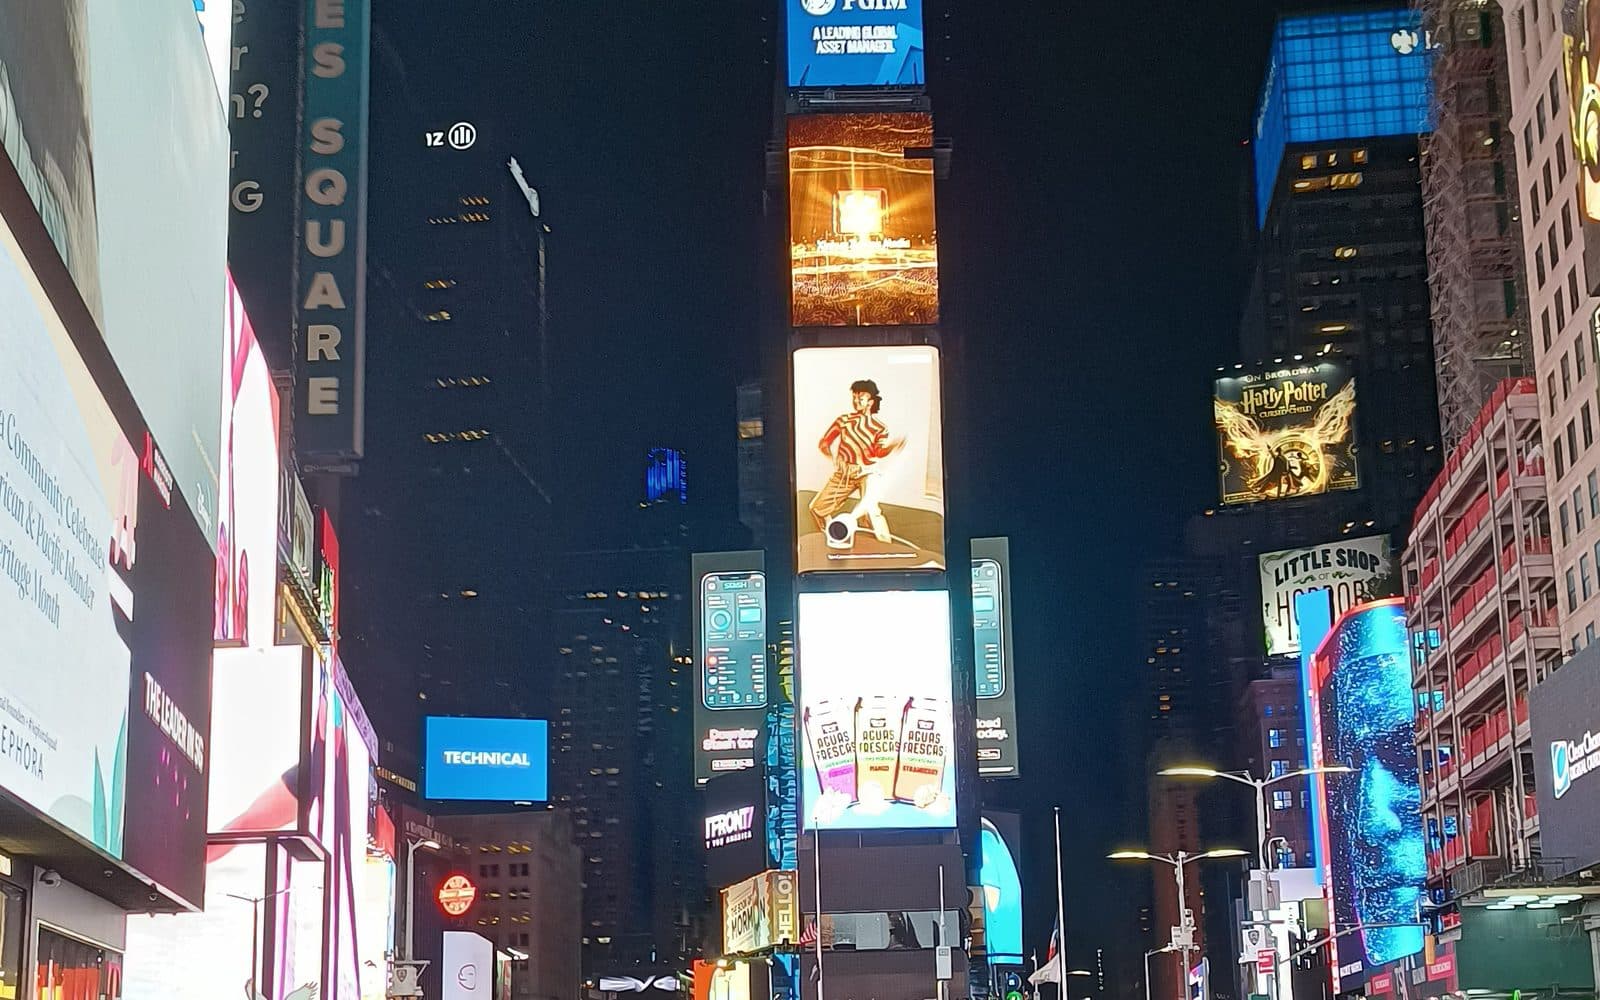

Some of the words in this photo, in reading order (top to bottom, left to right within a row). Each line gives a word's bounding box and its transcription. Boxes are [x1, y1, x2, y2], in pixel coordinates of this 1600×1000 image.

[303, 119, 348, 415] SQUARE
[1264, 365, 1321, 380] BROADWAY
[1241, 386, 1283, 415] Harry
[1282, 380, 1328, 411] Potter
[1274, 548, 1332, 587] LITTLE
[1335, 548, 1380, 573] SHOP
[144, 671, 161, 728] THE
[160, 689, 188, 755] LEADER
[817, 731, 850, 758] AGUAS
[862, 730, 895, 741] AGUAS
[908, 730, 941, 744] AGUAS
[443, 750, 531, 767] TECHNICAL
[902, 741, 944, 757] FRESCAS
